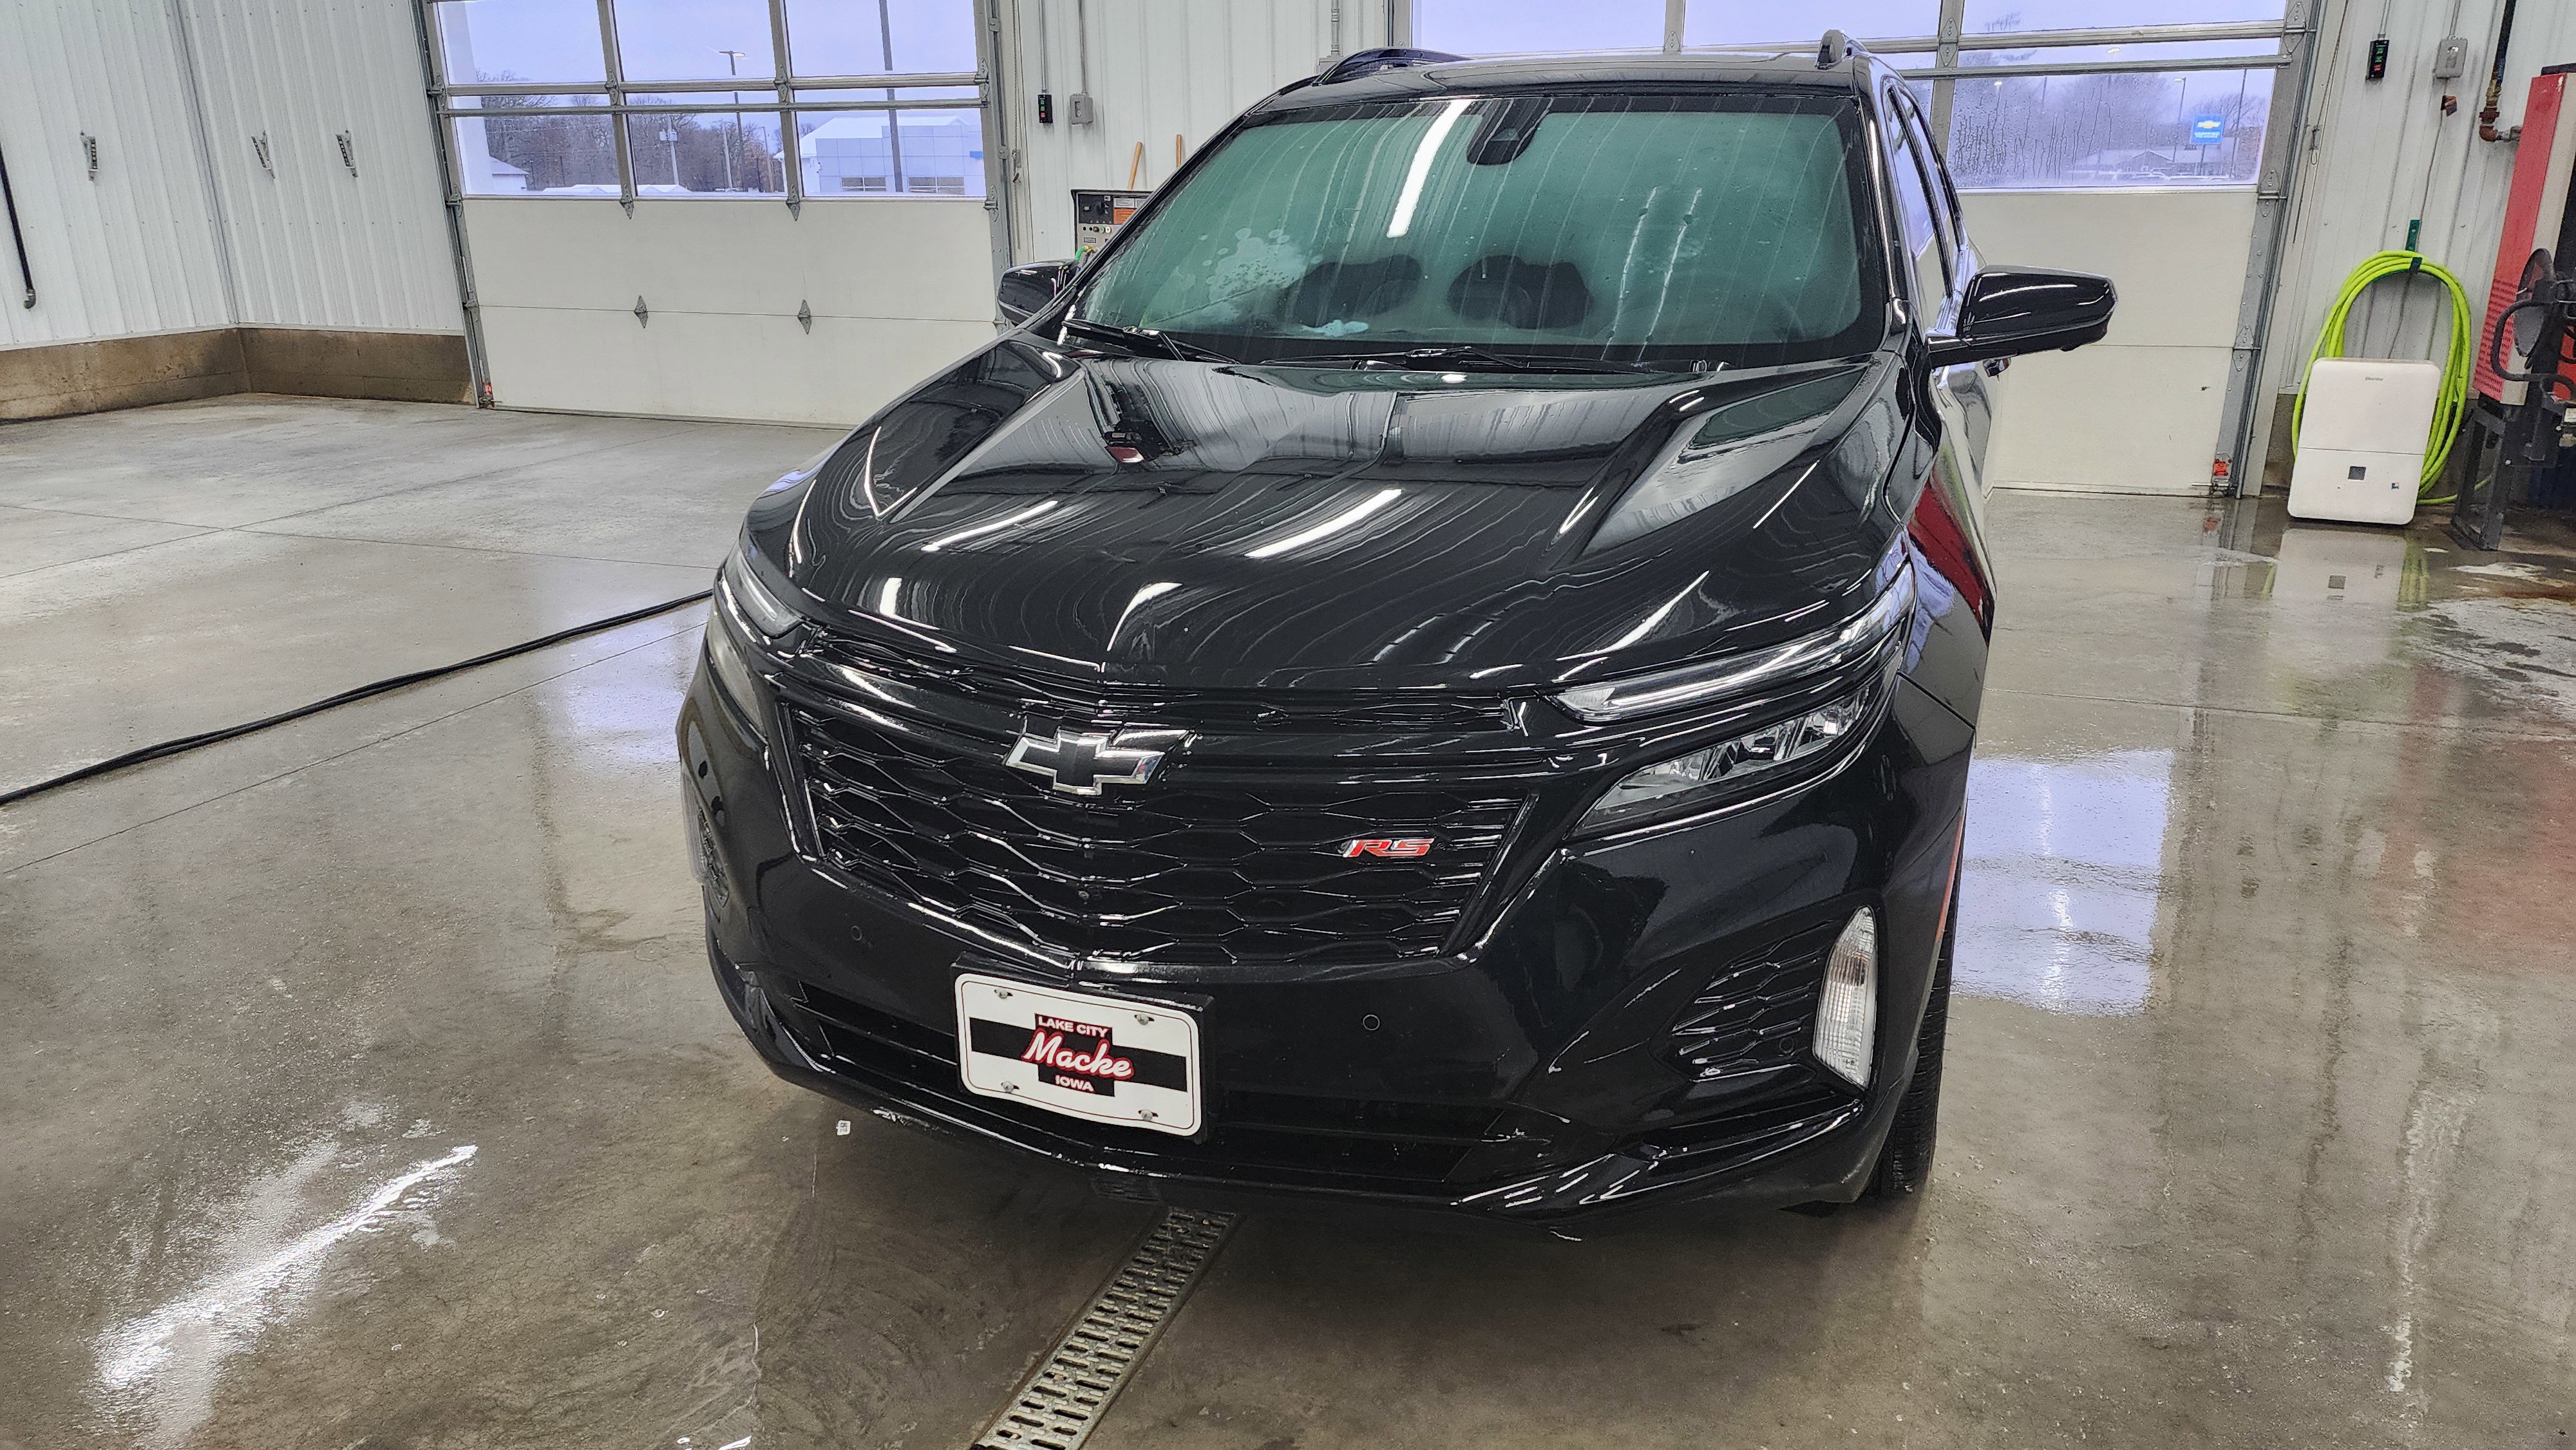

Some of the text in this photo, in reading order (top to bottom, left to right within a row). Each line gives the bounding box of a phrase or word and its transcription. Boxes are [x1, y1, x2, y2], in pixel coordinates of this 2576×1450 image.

[1343, 838, 1435, 858] RS
[1038, 1016, 1108, 1038] LAKE CITY
[1022, 1030, 1133, 1078] Macke
[1055, 1075, 1094, 1092] IOWA
